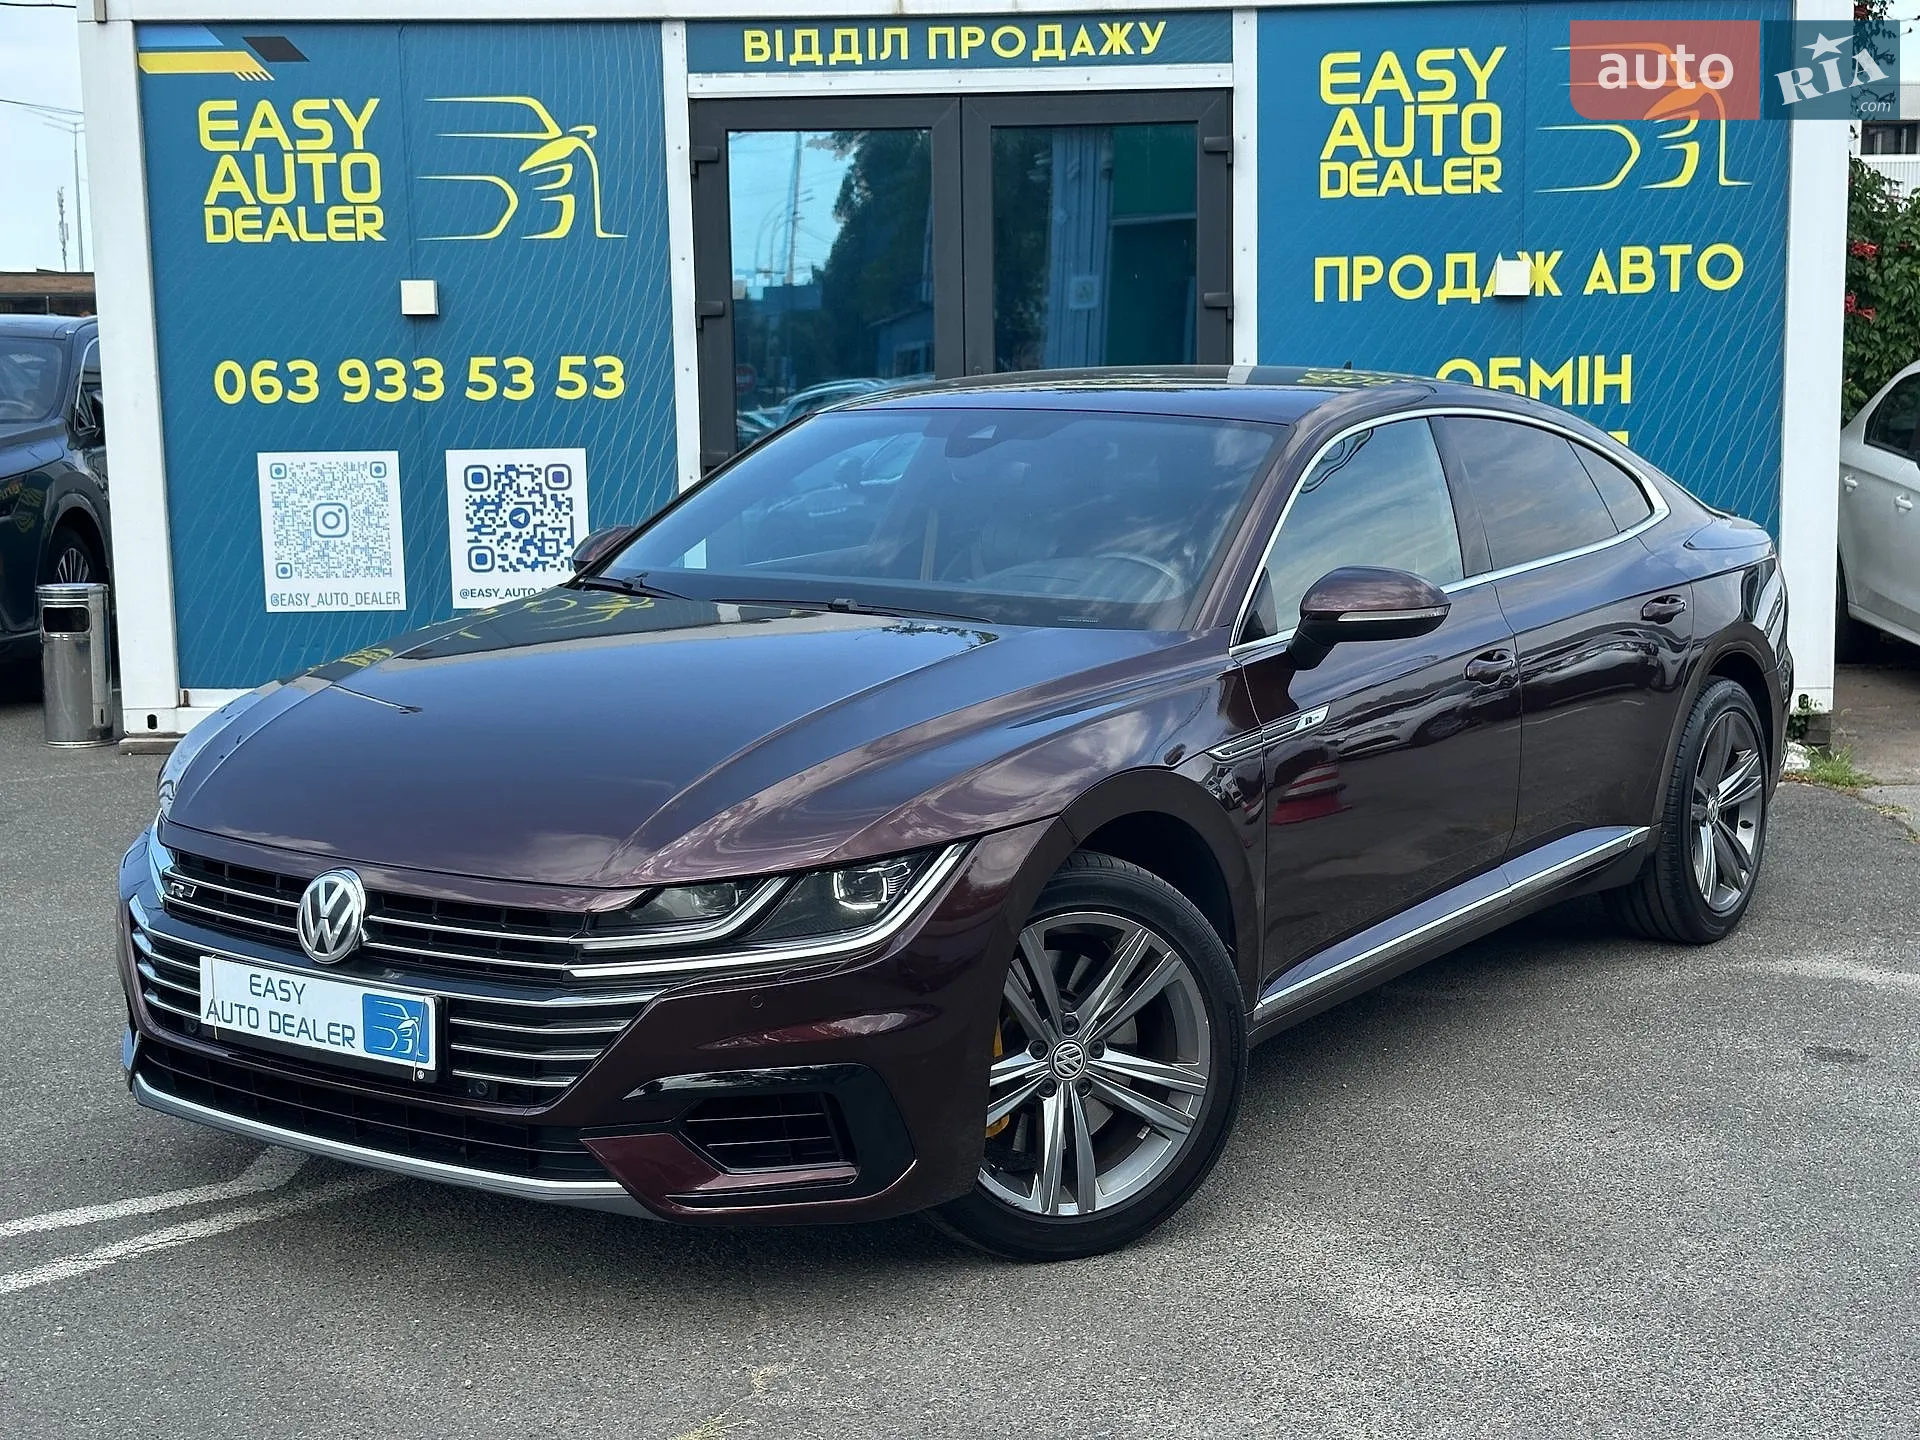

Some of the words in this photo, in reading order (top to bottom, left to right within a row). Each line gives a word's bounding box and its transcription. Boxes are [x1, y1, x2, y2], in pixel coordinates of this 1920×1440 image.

[744, 28, 909, 65] ВІДДІЛ
[928, 21, 1167, 62] ПРОДАЖУ
[1320, 47, 1506, 105] EASY
[199, 98, 380, 152] EASY
[1321, 102, 1503, 160] AUTO
[204, 152, 381, 206] AUTO
[1320, 157, 1502, 197] DEALER
[205, 205, 386, 243] DEALER
[1584, 243, 1745, 295] АВТО
[214, 360, 319, 404] 063
[339, 358, 444, 403] 933
[465, 356, 535, 401] 53
[555, 355, 625, 400] 53
[270, 591, 401, 608] @EASY_AUTO_DEALER
[249, 973, 306, 1005] EASY
[206, 998, 260, 1030] AUTO
[268, 1010, 356, 1049] DEALER
